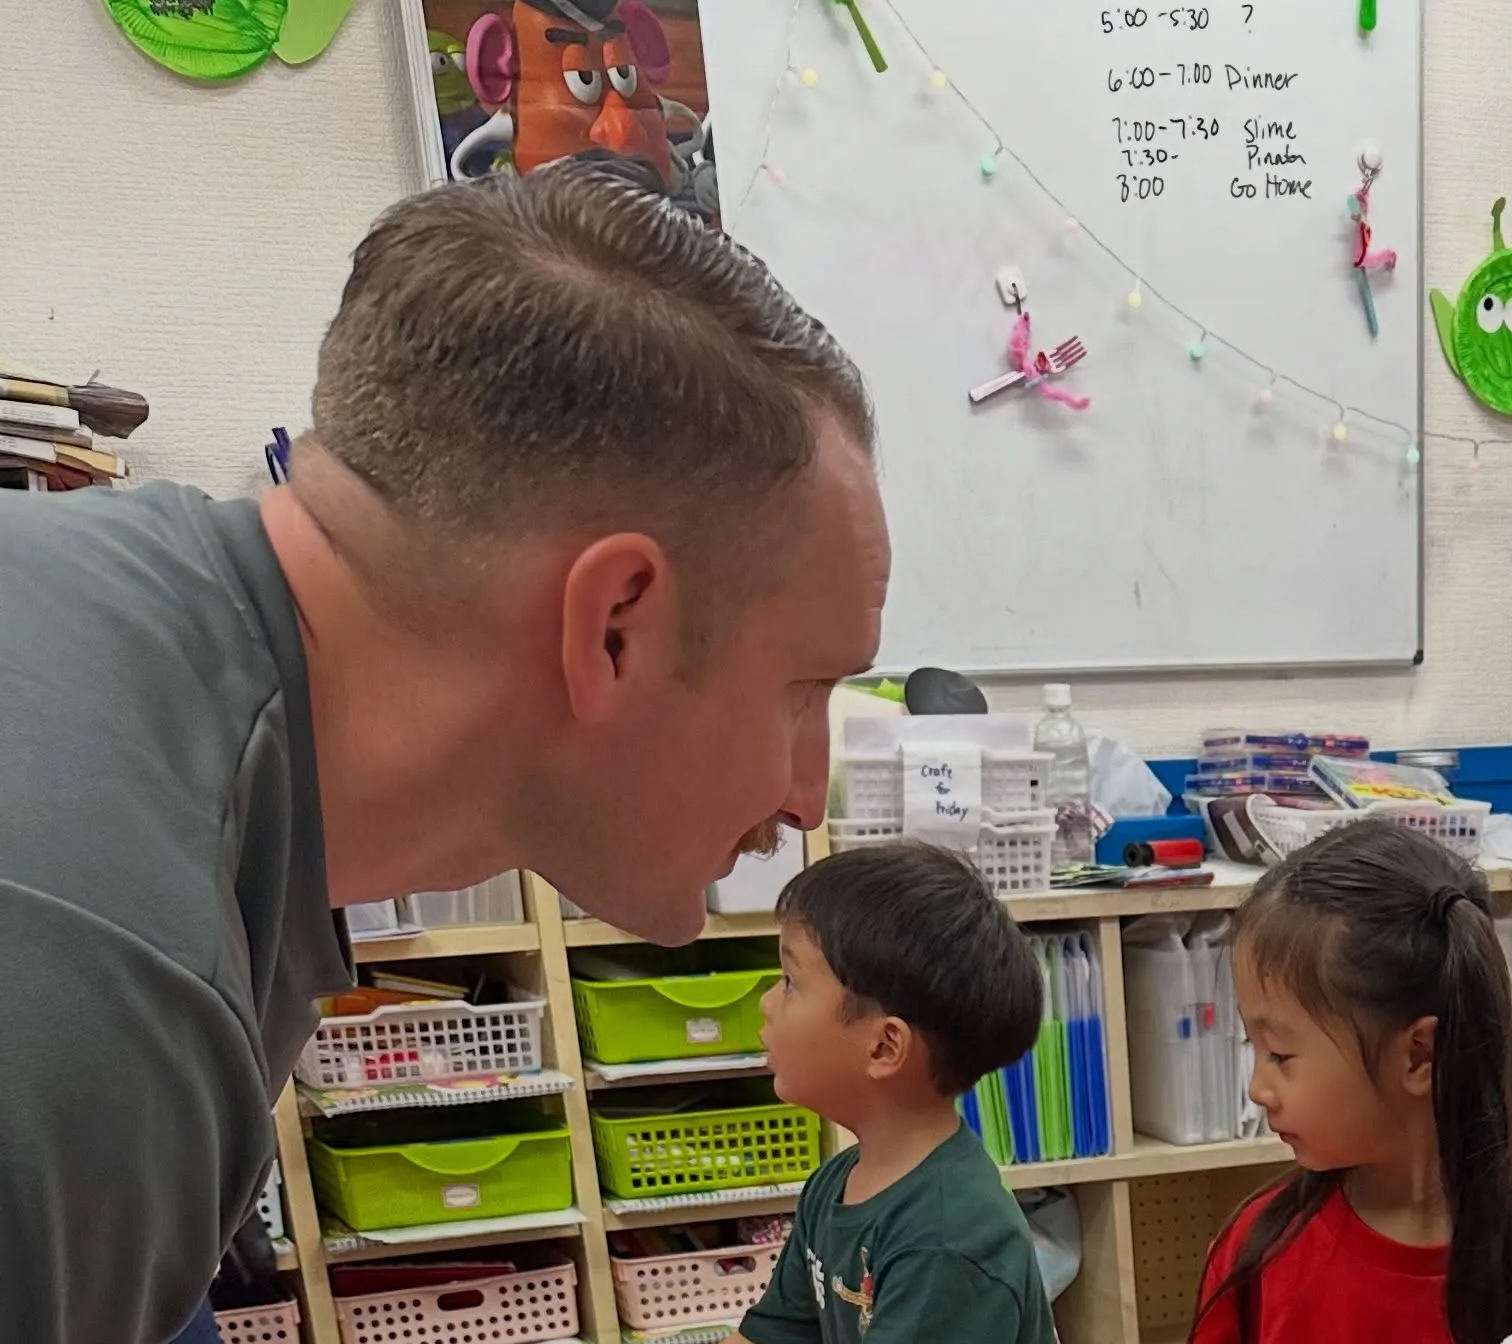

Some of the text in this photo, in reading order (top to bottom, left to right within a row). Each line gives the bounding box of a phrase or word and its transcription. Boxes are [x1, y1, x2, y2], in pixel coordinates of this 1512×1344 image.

[1241, 4, 1254, 34] ?
[1224, 64, 1299, 91] Dinner
[1116, 172, 1313, 203] 8:00 Go Home
[921, 763, 953, 780] Craft
[935, 801, 969, 822] Friday
